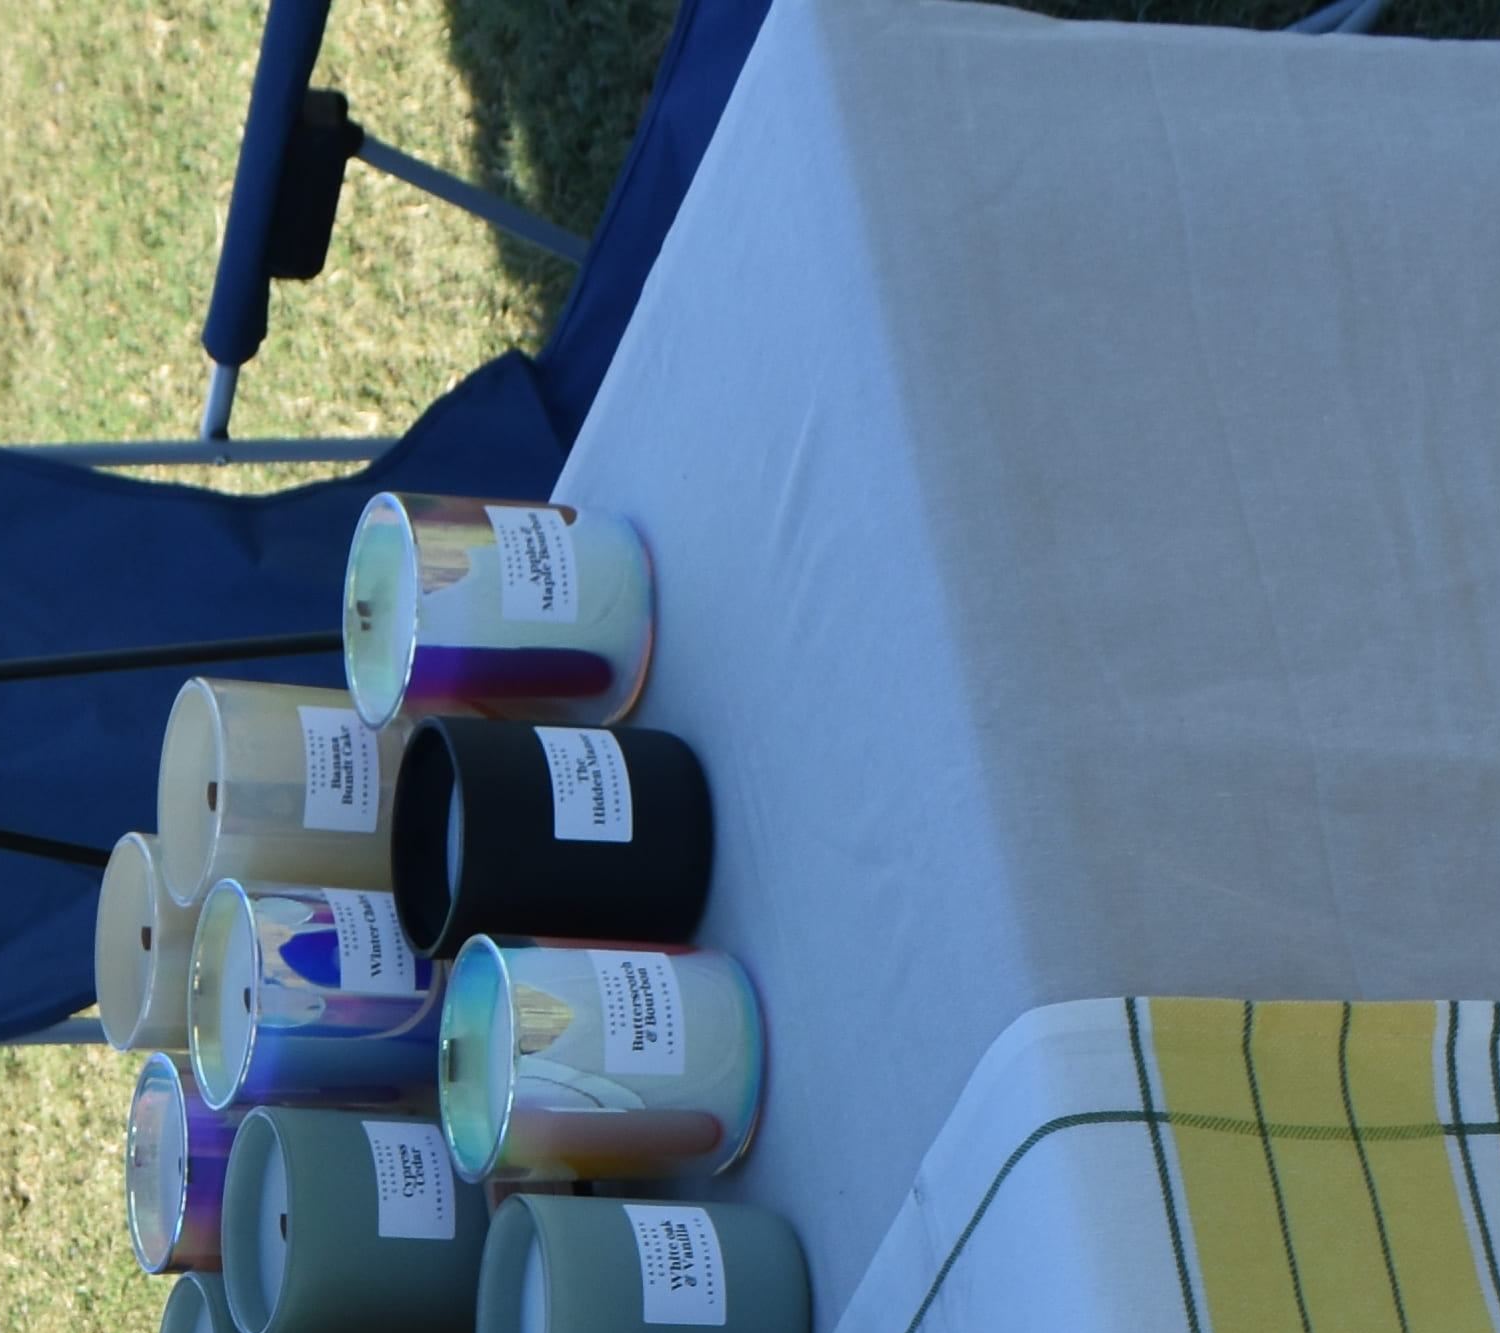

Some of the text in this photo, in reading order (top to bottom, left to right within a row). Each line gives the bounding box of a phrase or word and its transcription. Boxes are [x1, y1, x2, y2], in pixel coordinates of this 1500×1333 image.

[524, 535, 542, 587] Apples
[541, 562, 556, 612] Maple
[330, 737, 341, 789] Banana
[339, 725, 353, 805] Bundt Cake
[576, 757, 590, 783] The
[590, 769, 606, 826] Hidden
[368, 924, 382, 978] Winter
[620, 961, 645, 1051] Butterscotch
[637, 968, 657, 1043] & Bourbon
[398, 1144, 417, 1198] Cypress
[410, 1147, 425, 1187] Cedar
[659, 1221, 682, 1291] White oak
[675, 1224, 696, 1287] & Vanilla
